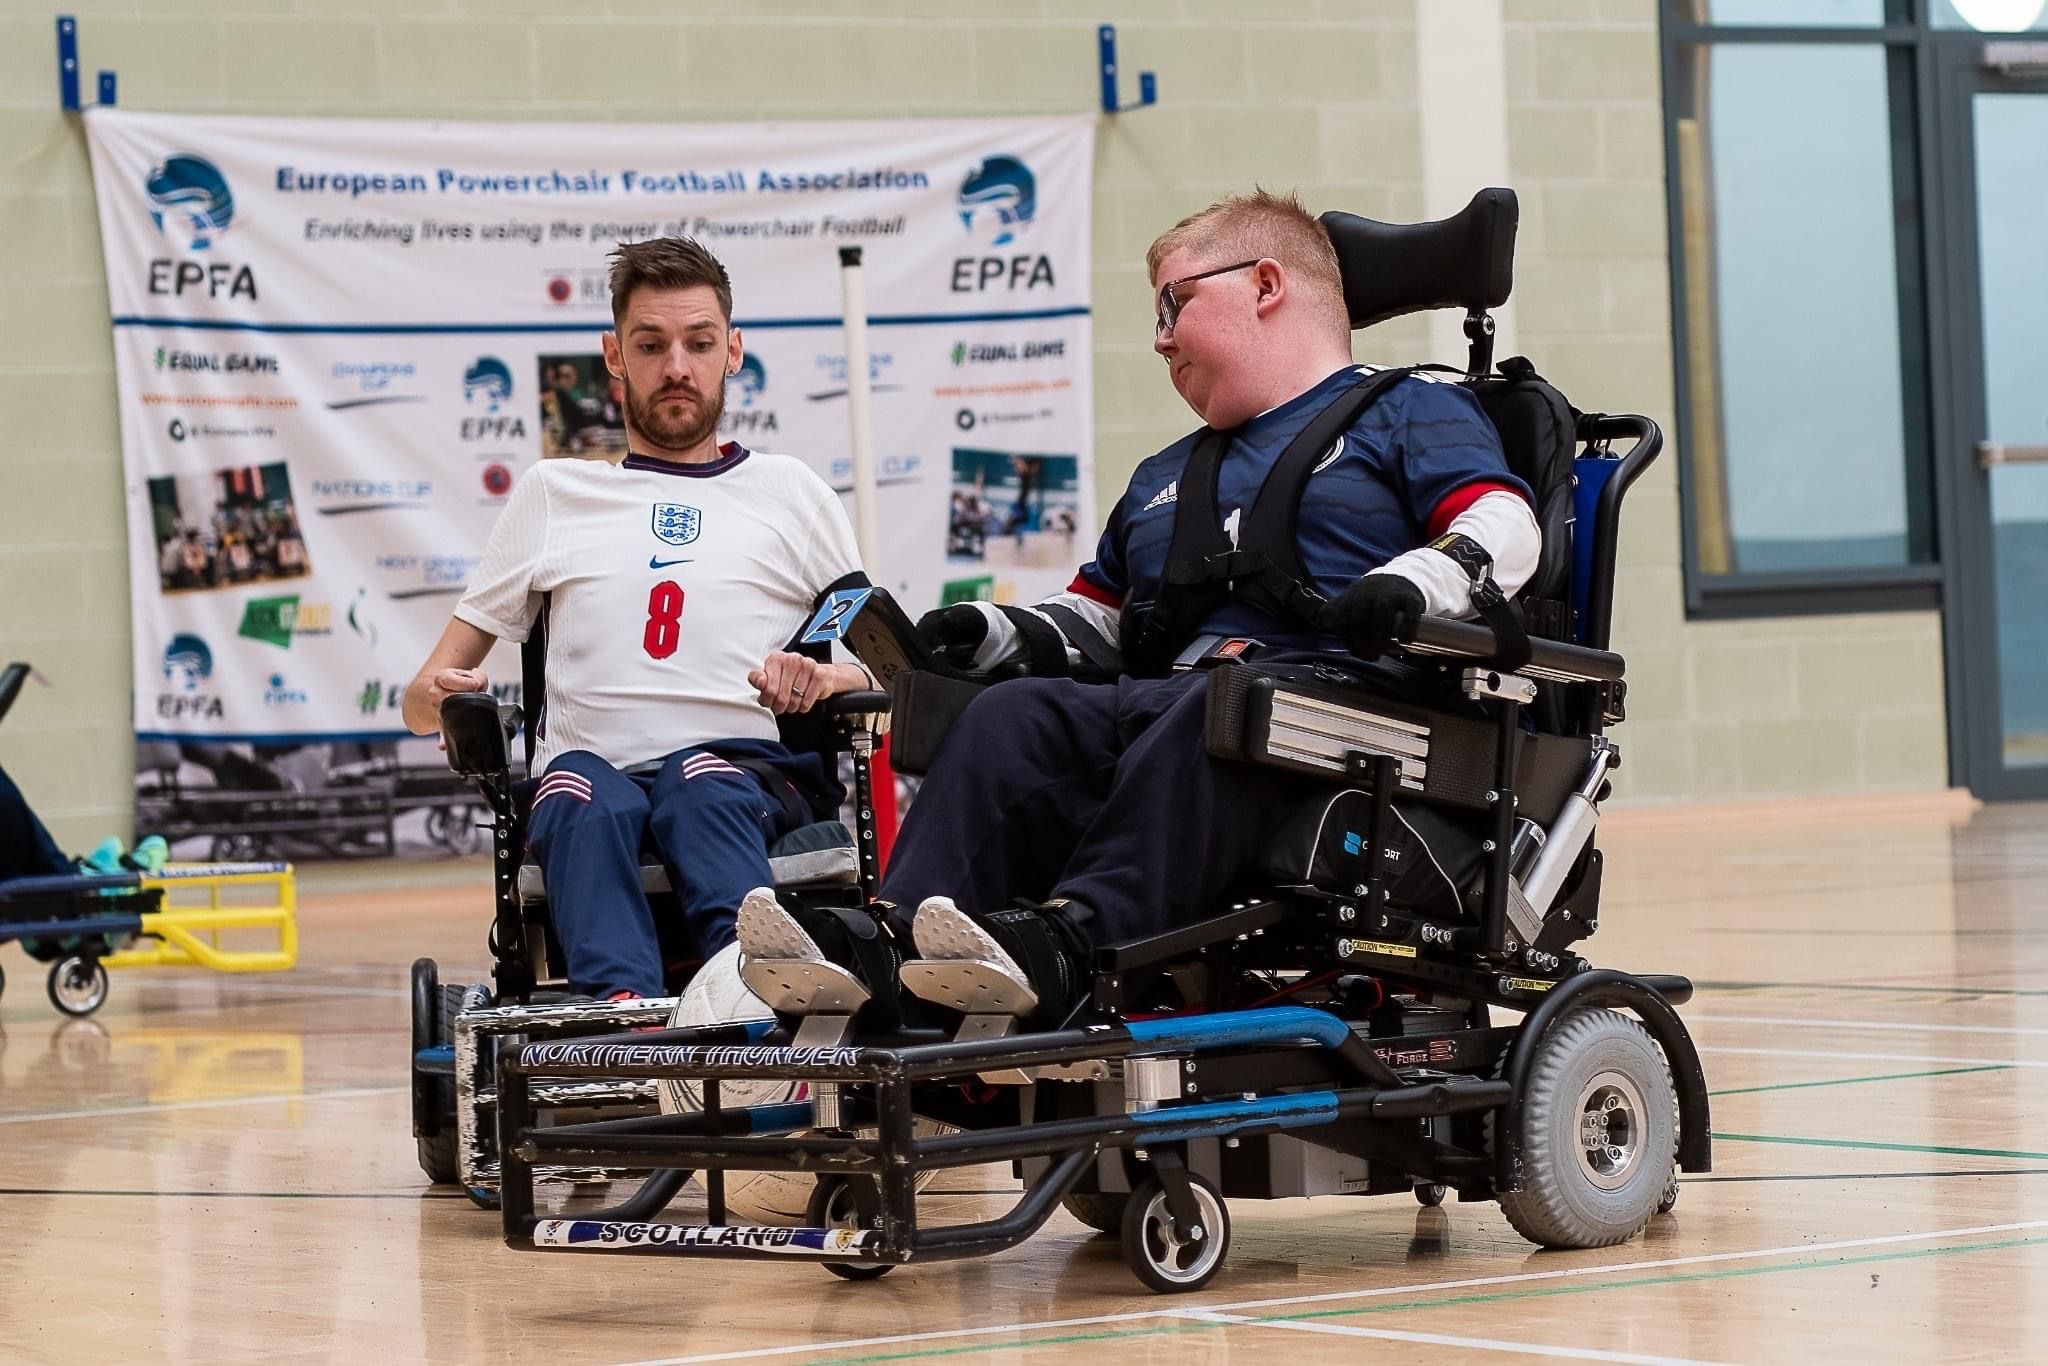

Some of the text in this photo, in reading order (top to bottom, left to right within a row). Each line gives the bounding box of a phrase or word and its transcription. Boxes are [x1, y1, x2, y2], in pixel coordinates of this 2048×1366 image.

[277, 167, 930, 198] European Powerchair Football Association
[304, 215, 906, 246] Enriching lives using the power of Powerchair Football
[148, 260, 259, 302] EPFA
[951, 254, 1055, 293] EPFA
[460, 417, 526, 440] EPFA
[643, 580, 686, 660] 8
[815, 598, 855, 632] 2
[157, 693, 224, 719] EPFA
[1362, 840, 1402, 861] CORT
[1513, 980, 1536, 990] AUTION
[520, 1044, 861, 1068] NORTHERN THUNDER
[1396, 1053, 1429, 1065] FORCE
[600, 1222, 794, 1248] SCOTLAND
